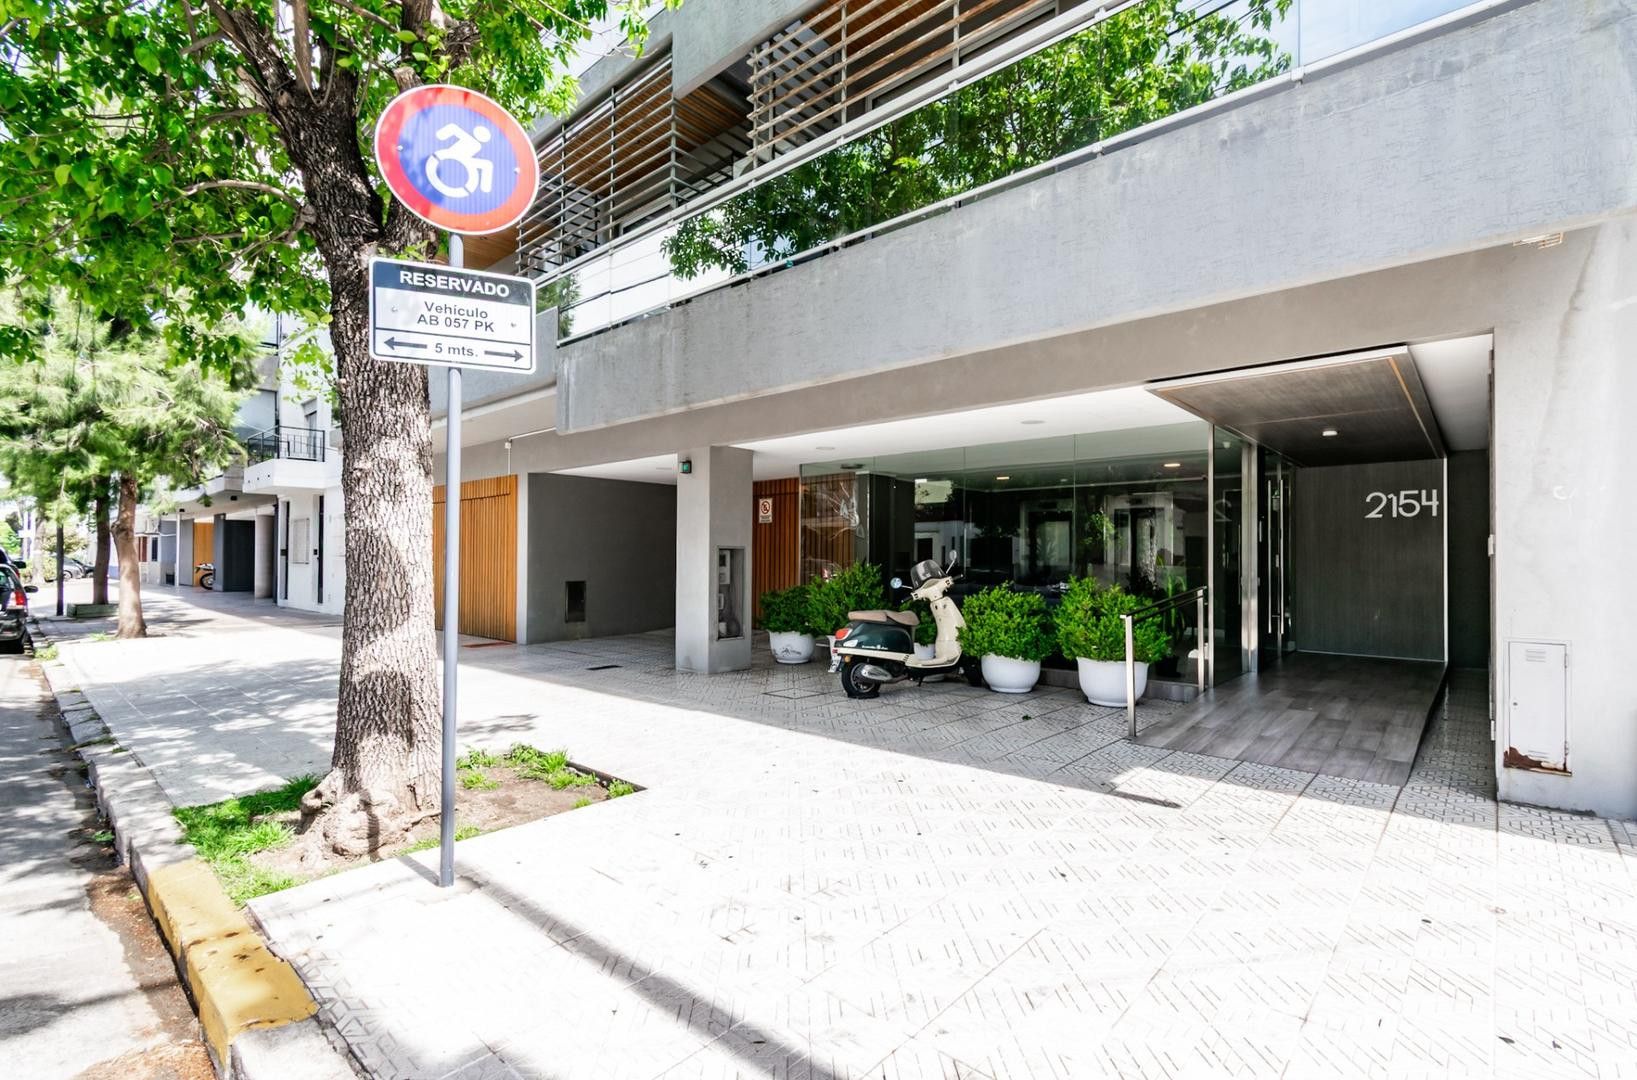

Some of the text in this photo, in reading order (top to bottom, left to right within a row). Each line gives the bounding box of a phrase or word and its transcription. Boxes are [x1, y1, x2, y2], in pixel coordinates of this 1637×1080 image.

[400, 270, 510, 298] RESERVADO
[416, 313, 495, 332] AB 057 PK
[435, 342, 479, 358] 5 mts.
[1364, 489, 1439, 518] 2154
